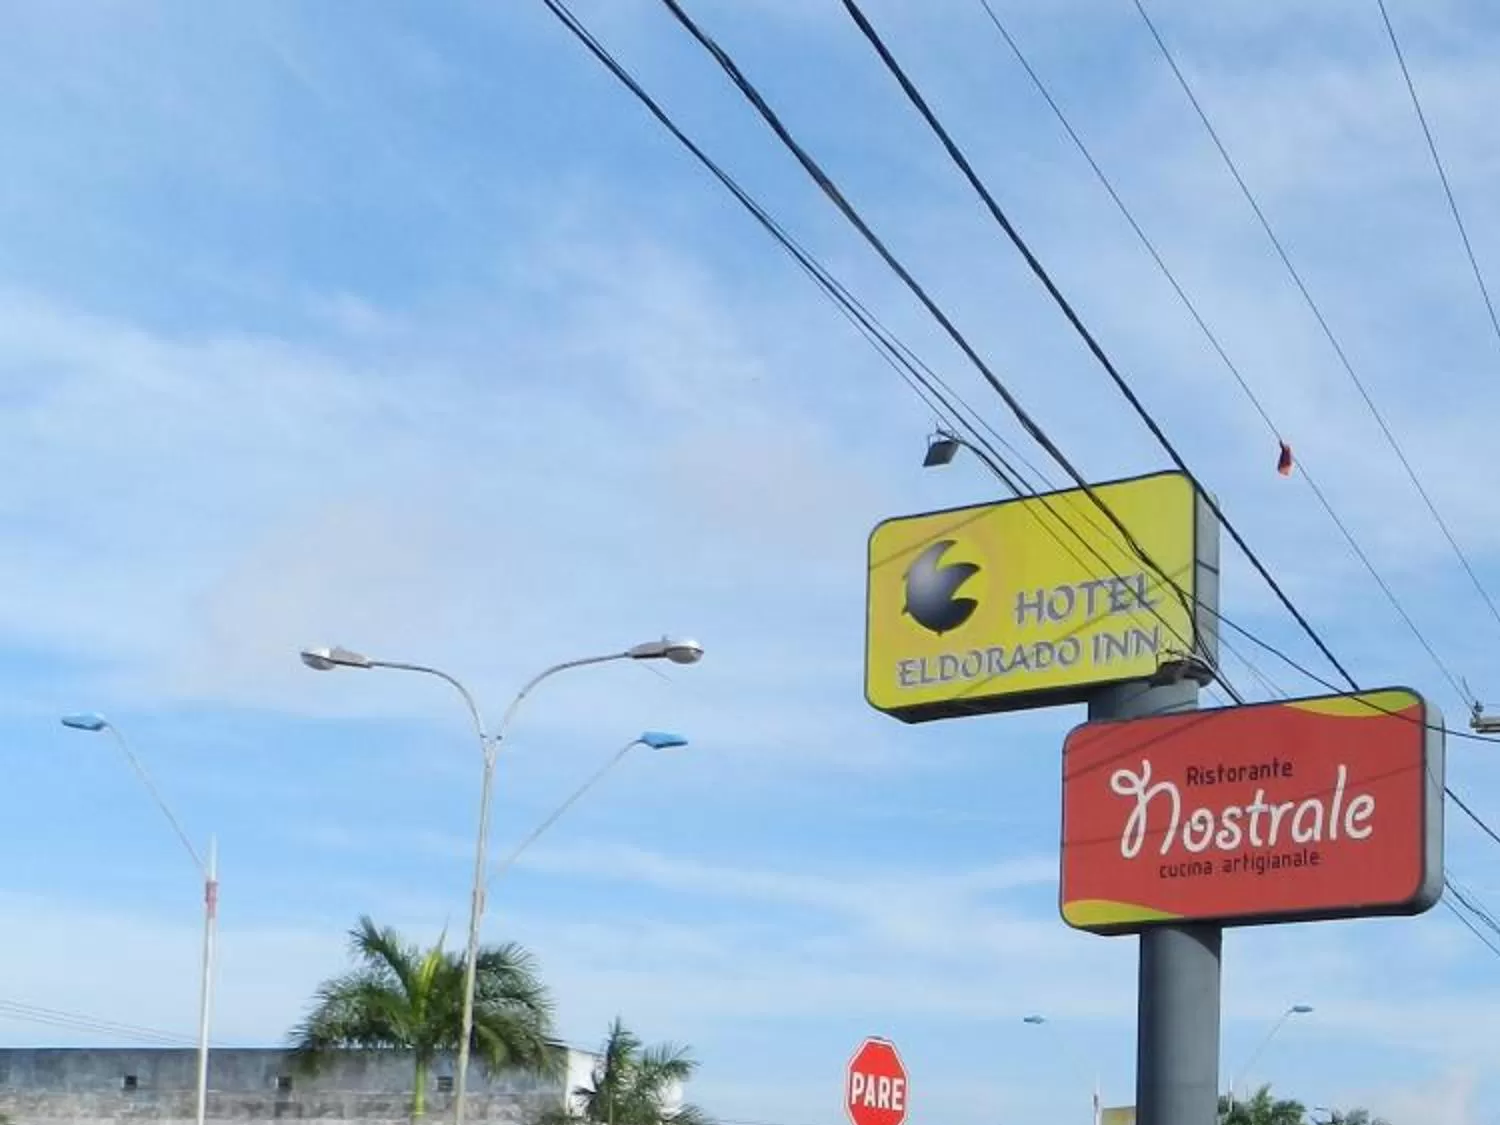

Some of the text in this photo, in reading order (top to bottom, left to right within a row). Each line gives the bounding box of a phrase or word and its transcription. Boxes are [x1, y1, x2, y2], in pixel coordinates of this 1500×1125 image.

[1014, 572, 1162, 626] HOTEL
[897, 624, 1160, 688] ELDORADO INN
[1186, 757, 1294, 787] Ristorante
[1110, 759, 1377, 858] Nostrale
[1158, 848, 1321, 879] cucina artigianale
[851, 1071, 904, 1111] PARE
